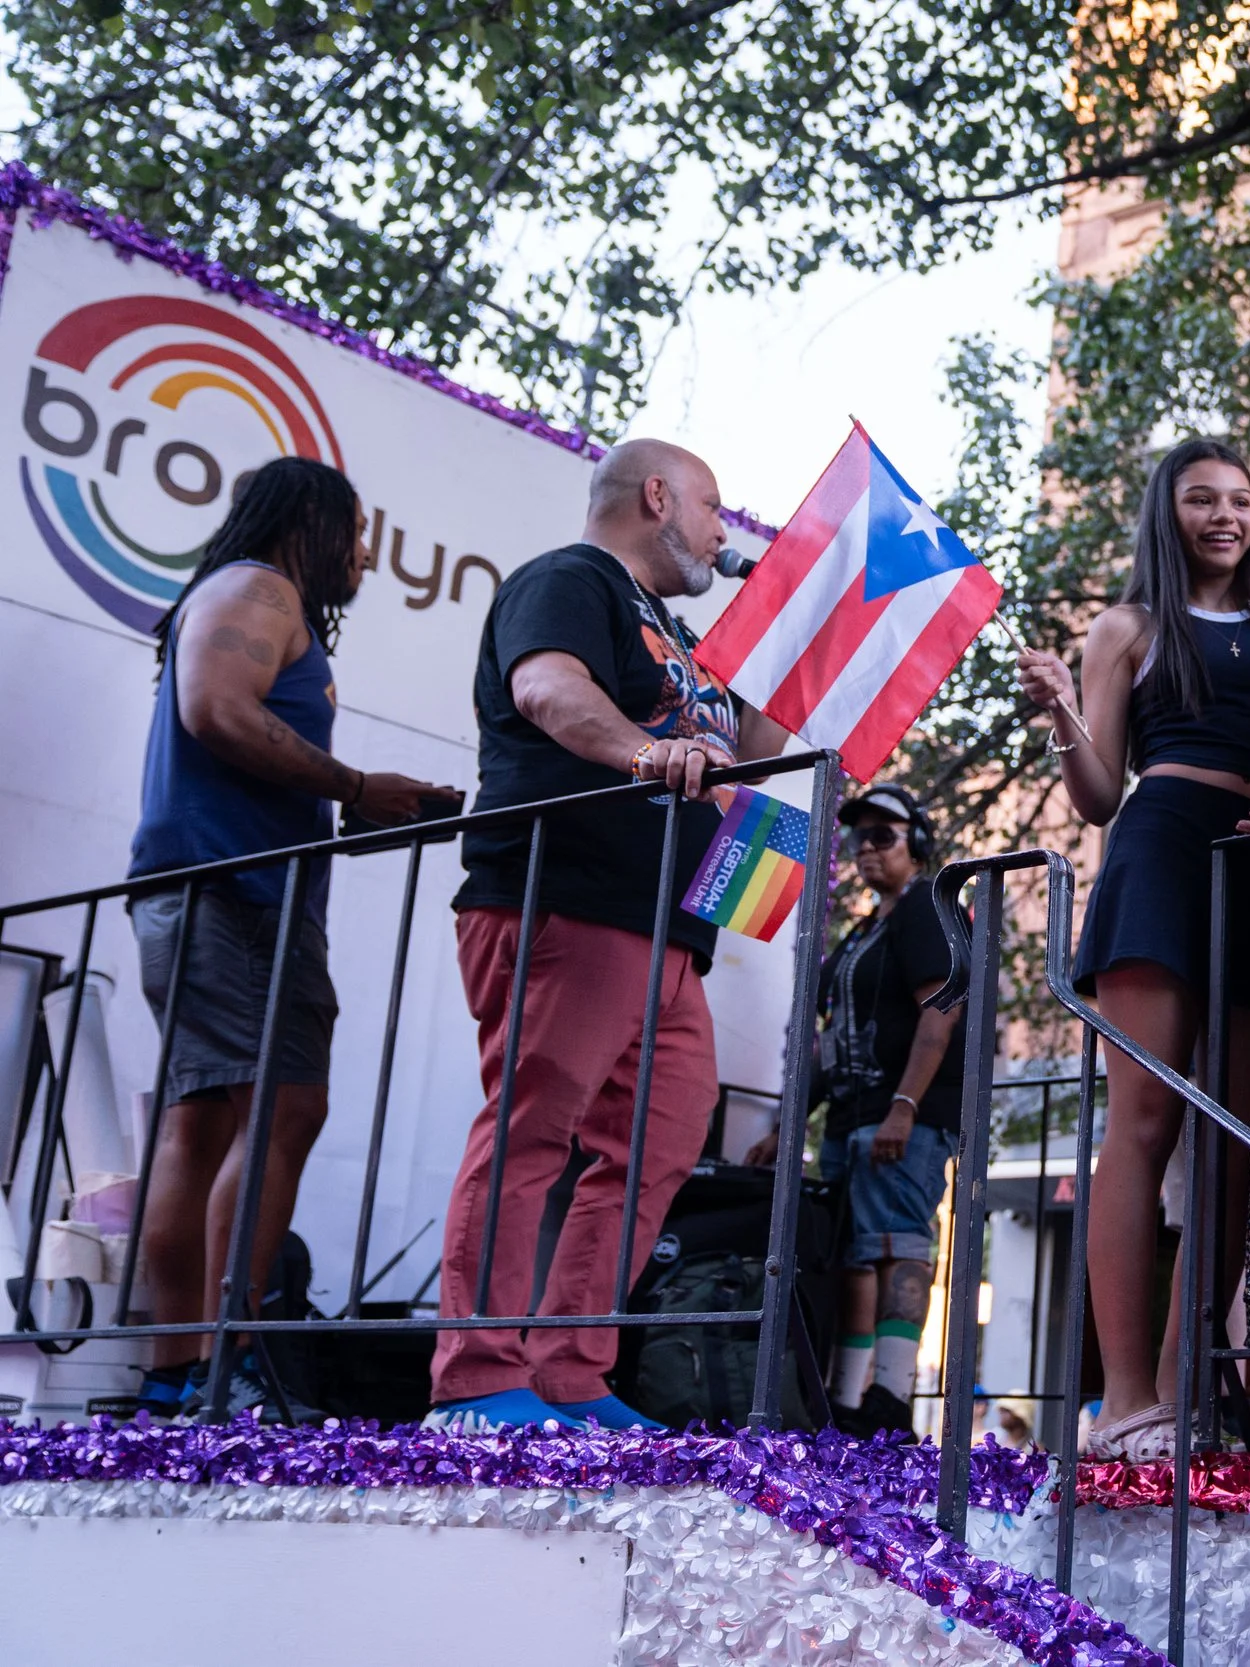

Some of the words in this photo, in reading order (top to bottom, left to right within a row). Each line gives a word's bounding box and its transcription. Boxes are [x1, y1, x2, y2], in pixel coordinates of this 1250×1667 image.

[22, 365, 503, 610] brolyn
[702, 836, 732, 884] Outreach
[703, 840, 747, 913] LGBTQIA+
[690, 883, 707, 908] Unit
